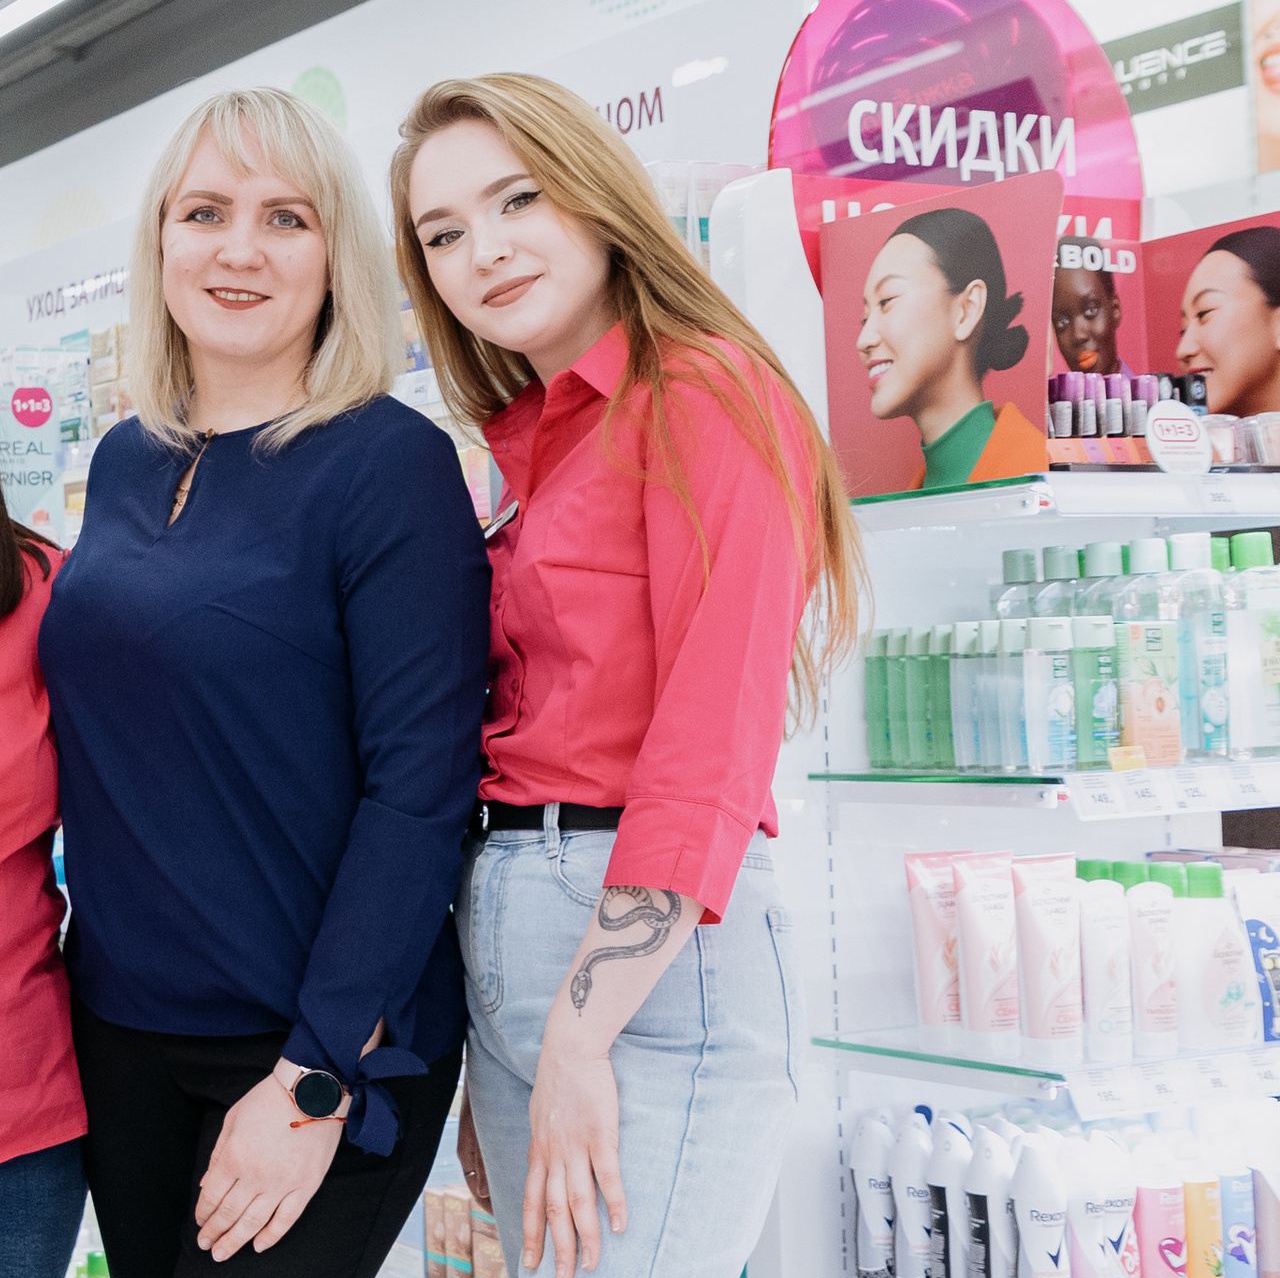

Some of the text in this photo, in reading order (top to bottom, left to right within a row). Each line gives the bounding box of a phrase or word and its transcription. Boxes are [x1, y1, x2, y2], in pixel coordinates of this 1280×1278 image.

[1114, 30, 1227, 83] UENCE
[848, 99, 1076, 182] СКИДКИ
[1060, 243, 1137, 274] BOLD
[27, 287, 66, 322] УХОД
[13, 398, 52, 414] 1+1=3
